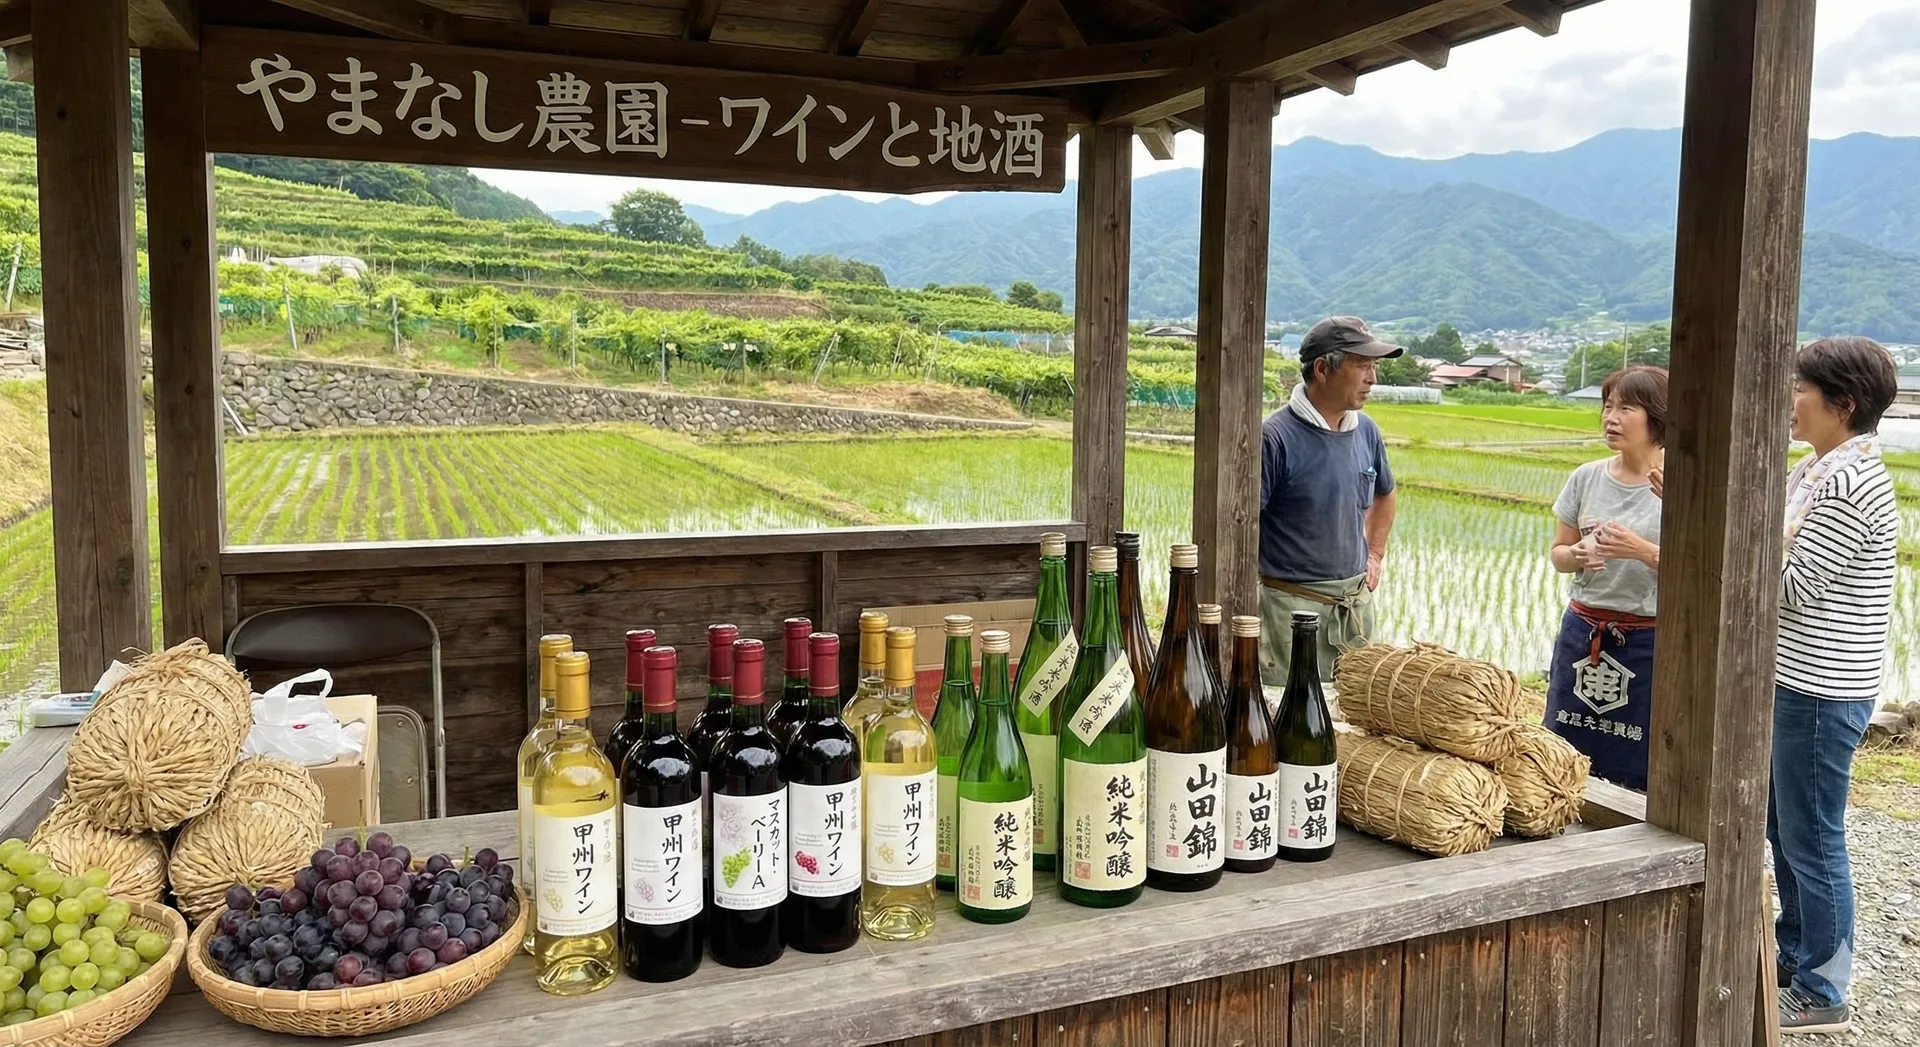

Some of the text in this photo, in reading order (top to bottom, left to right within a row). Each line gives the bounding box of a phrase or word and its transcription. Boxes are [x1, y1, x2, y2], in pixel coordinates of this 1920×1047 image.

[824, 791, 844, 877] 甲州ワイン
[903, 782, 922, 866] 甲州ワイン
[1105, 774, 1135, 879] 純米吟醸
[1182, 763, 1218, 860] 山田錦
[1245, 781, 1271, 854] 山田錦
[1300, 772, 1328, 843] 山田錦
[572, 823, 595, 915] 甲州ワイン
[661, 813, 683, 903] 甲州ワイン
[993, 811, 1020, 900] 純米吟醸
